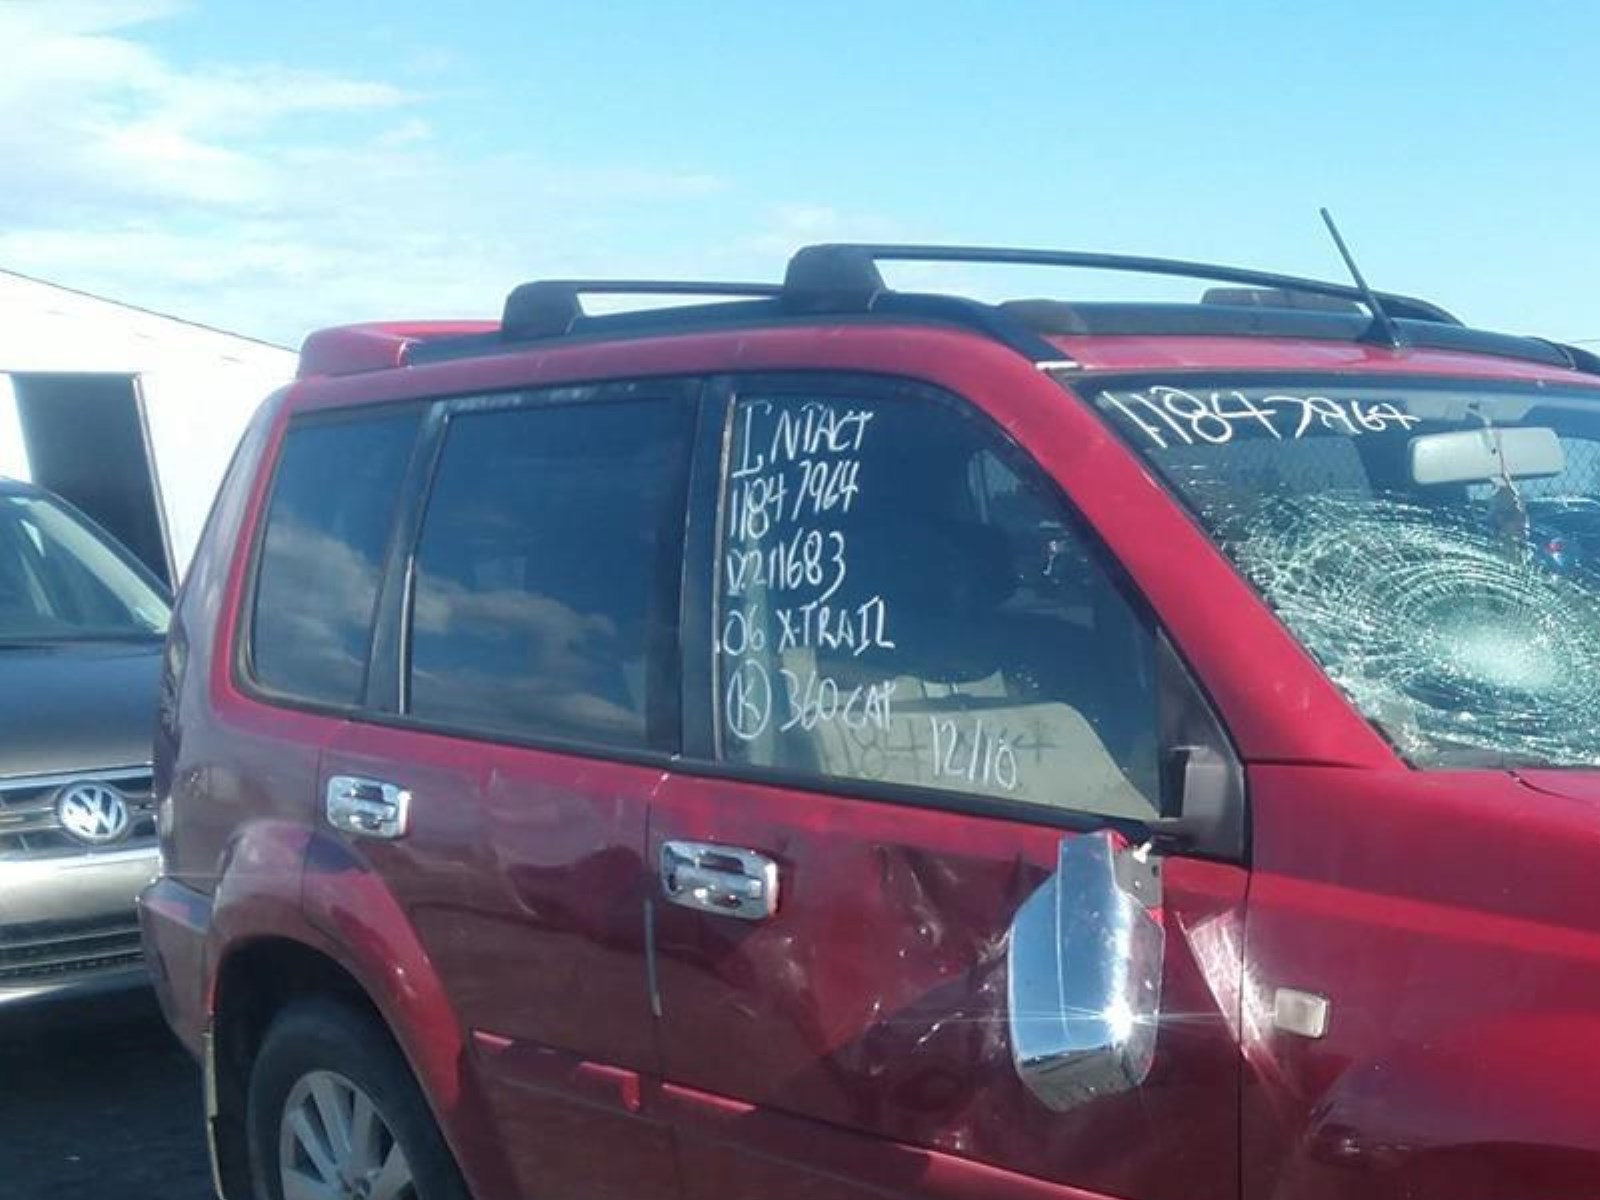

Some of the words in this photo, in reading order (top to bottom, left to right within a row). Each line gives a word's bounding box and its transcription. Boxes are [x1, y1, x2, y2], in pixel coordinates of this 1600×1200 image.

[730, 400, 874, 478] INTACT
[1102, 386, 1422, 449] 11847964
[723, 603, 767, 656] 06
[928, 715, 1018, 791] 12/10
